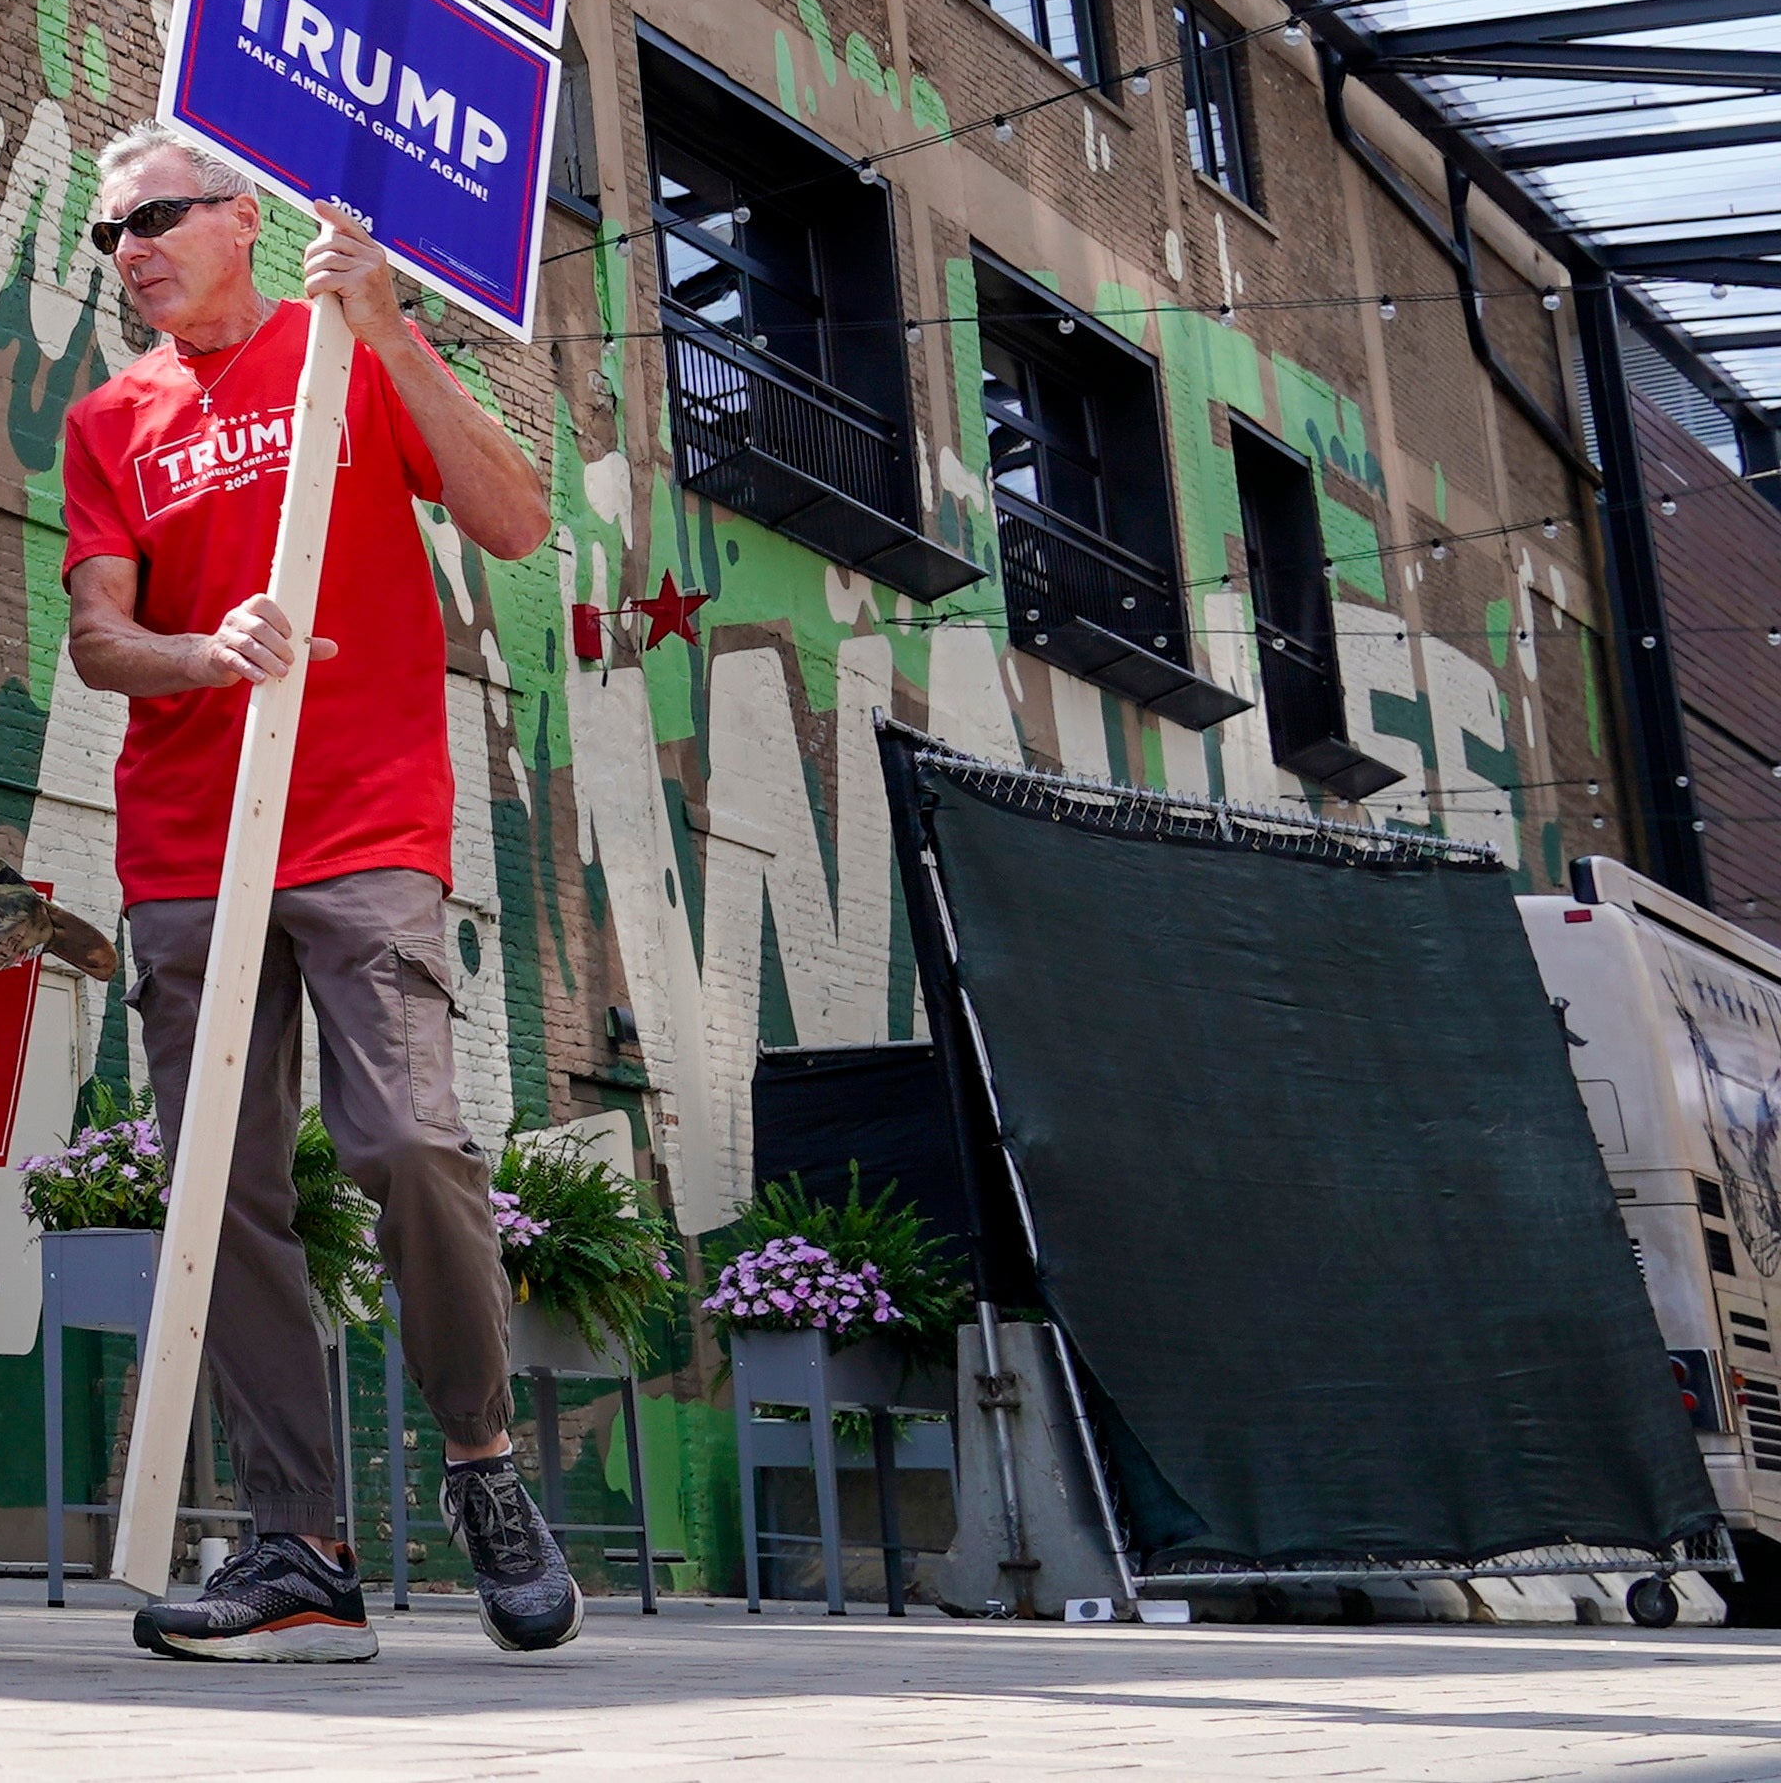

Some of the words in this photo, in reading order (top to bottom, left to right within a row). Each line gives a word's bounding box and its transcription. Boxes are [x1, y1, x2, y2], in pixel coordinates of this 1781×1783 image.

[237, 33, 287, 77] MAKE
[289, 69, 368, 127] AMERICA
[371, 119, 427, 163] GREAT
[430, 157, 490, 203] AGAIN!
[329, 194, 375, 234] 2024
[158, 417, 296, 484] TRUM
[171, 477, 200, 495] MAKE
[200, 465, 242, 483] AMERICA
[242, 451, 274, 468] GREAT
[224, 469, 259, 492] 2024
